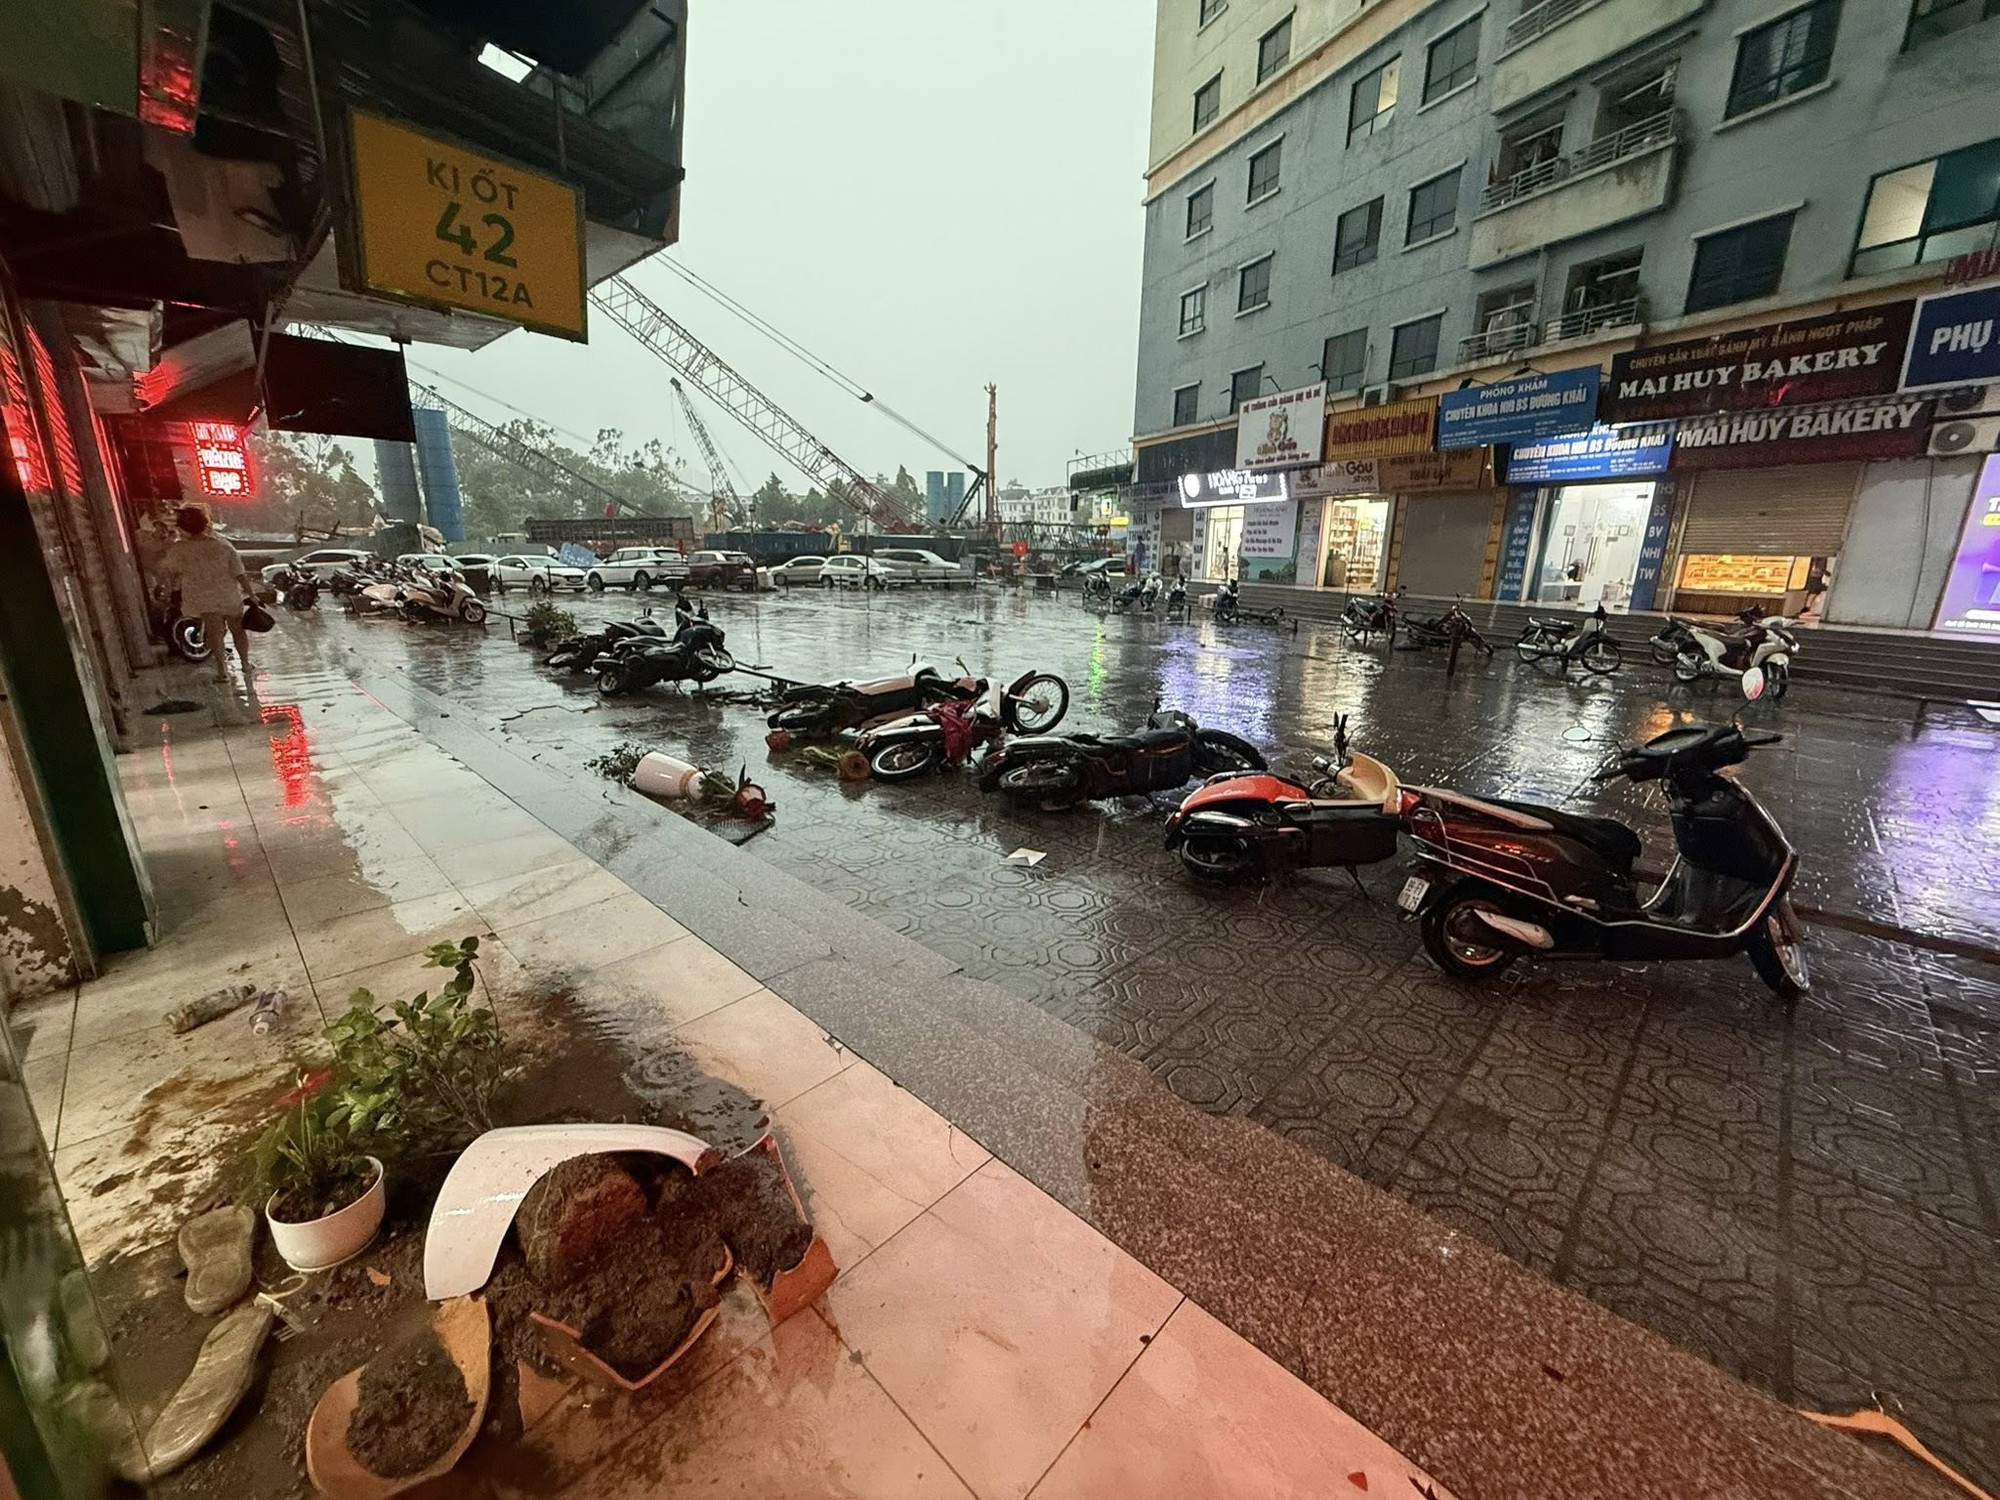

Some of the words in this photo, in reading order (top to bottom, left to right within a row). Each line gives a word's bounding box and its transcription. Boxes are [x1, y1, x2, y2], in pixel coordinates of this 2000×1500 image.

[425, 158, 460, 193] KI
[471, 168, 519, 211] ỐT
[436, 201, 518, 268] 42
[424, 259, 534, 308] CT12A
[1929, 319, 1994, 356] PHỤ
[1480, 383, 1515, 400] PHÒNG
[1518, 376, 1548, 394] KHÁM
[1618, 376, 1669, 399] MAI
[1672, 365, 1737, 392] HUY
[1740, 341, 1888, 383] BAKERY
[1679, 422, 1727, 449] MAI
[1728, 416, 1789, 444] HUY
[1789, 401, 1923, 439] BAKERY
[1653, 504, 1667, 517] BS
[1648, 525, 1664, 538] BV
[1641, 547, 1661, 559] NHI
[1640, 567, 1656, 580] TW
